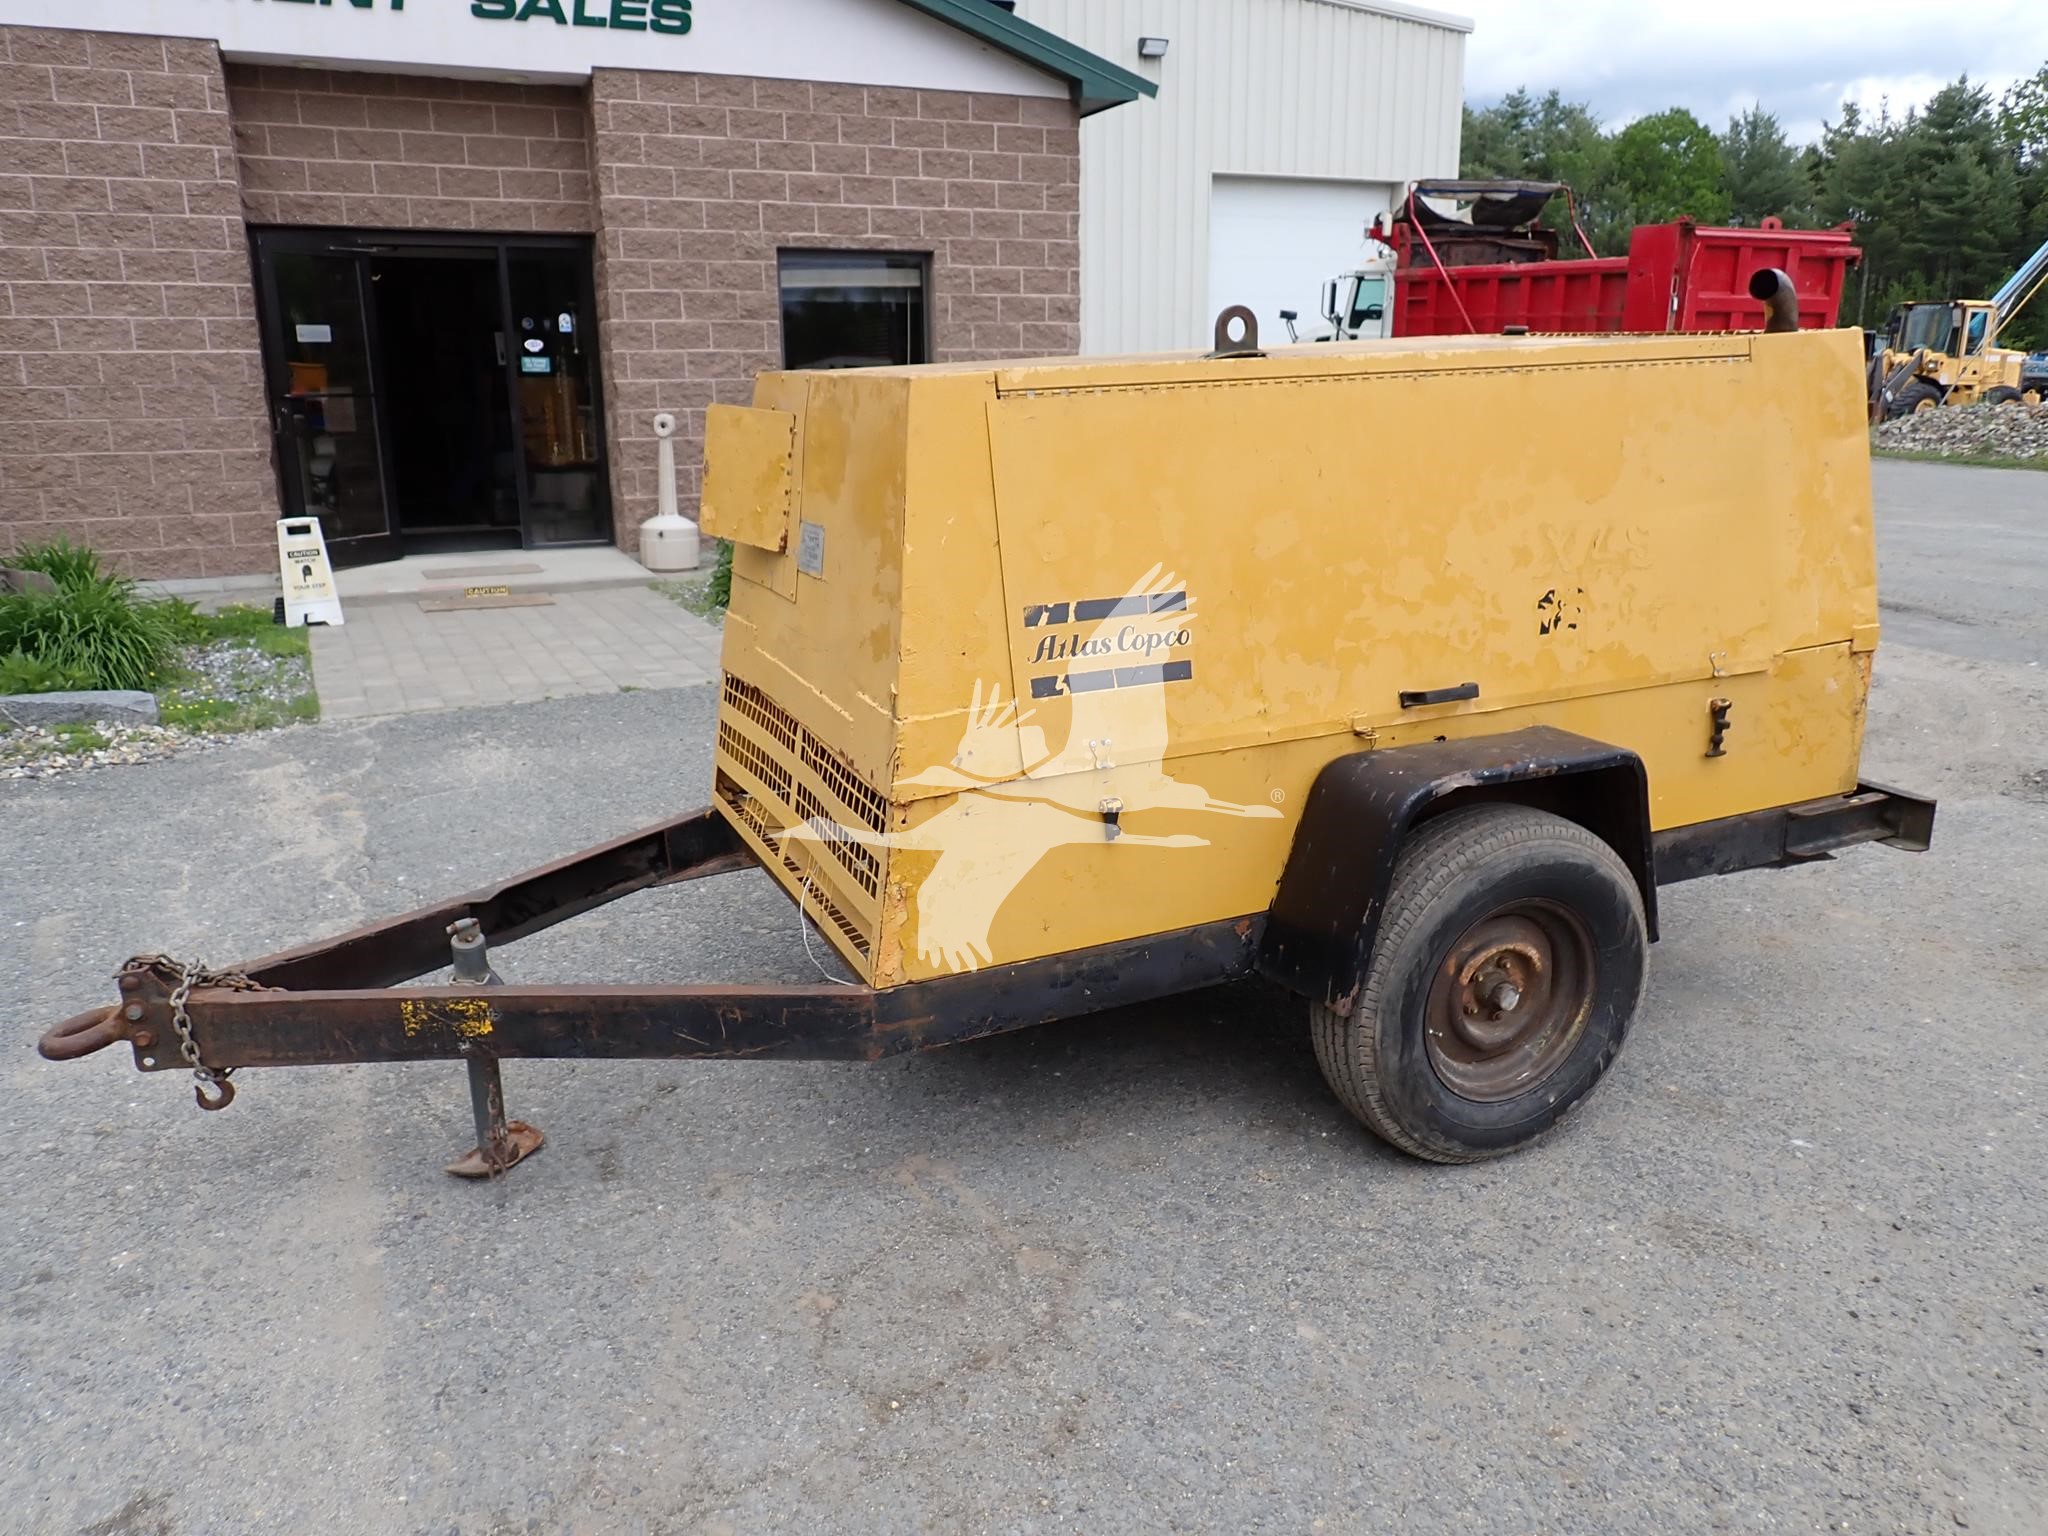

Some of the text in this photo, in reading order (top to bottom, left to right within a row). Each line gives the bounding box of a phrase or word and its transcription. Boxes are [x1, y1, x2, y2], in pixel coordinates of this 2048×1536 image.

[471, 0, 692, 35] SALES
[289, 550, 318, 558] CAUTION
[468, 586, 506, 595] CAUTION
[1027, 625, 1190, 663] Atlas Copco
